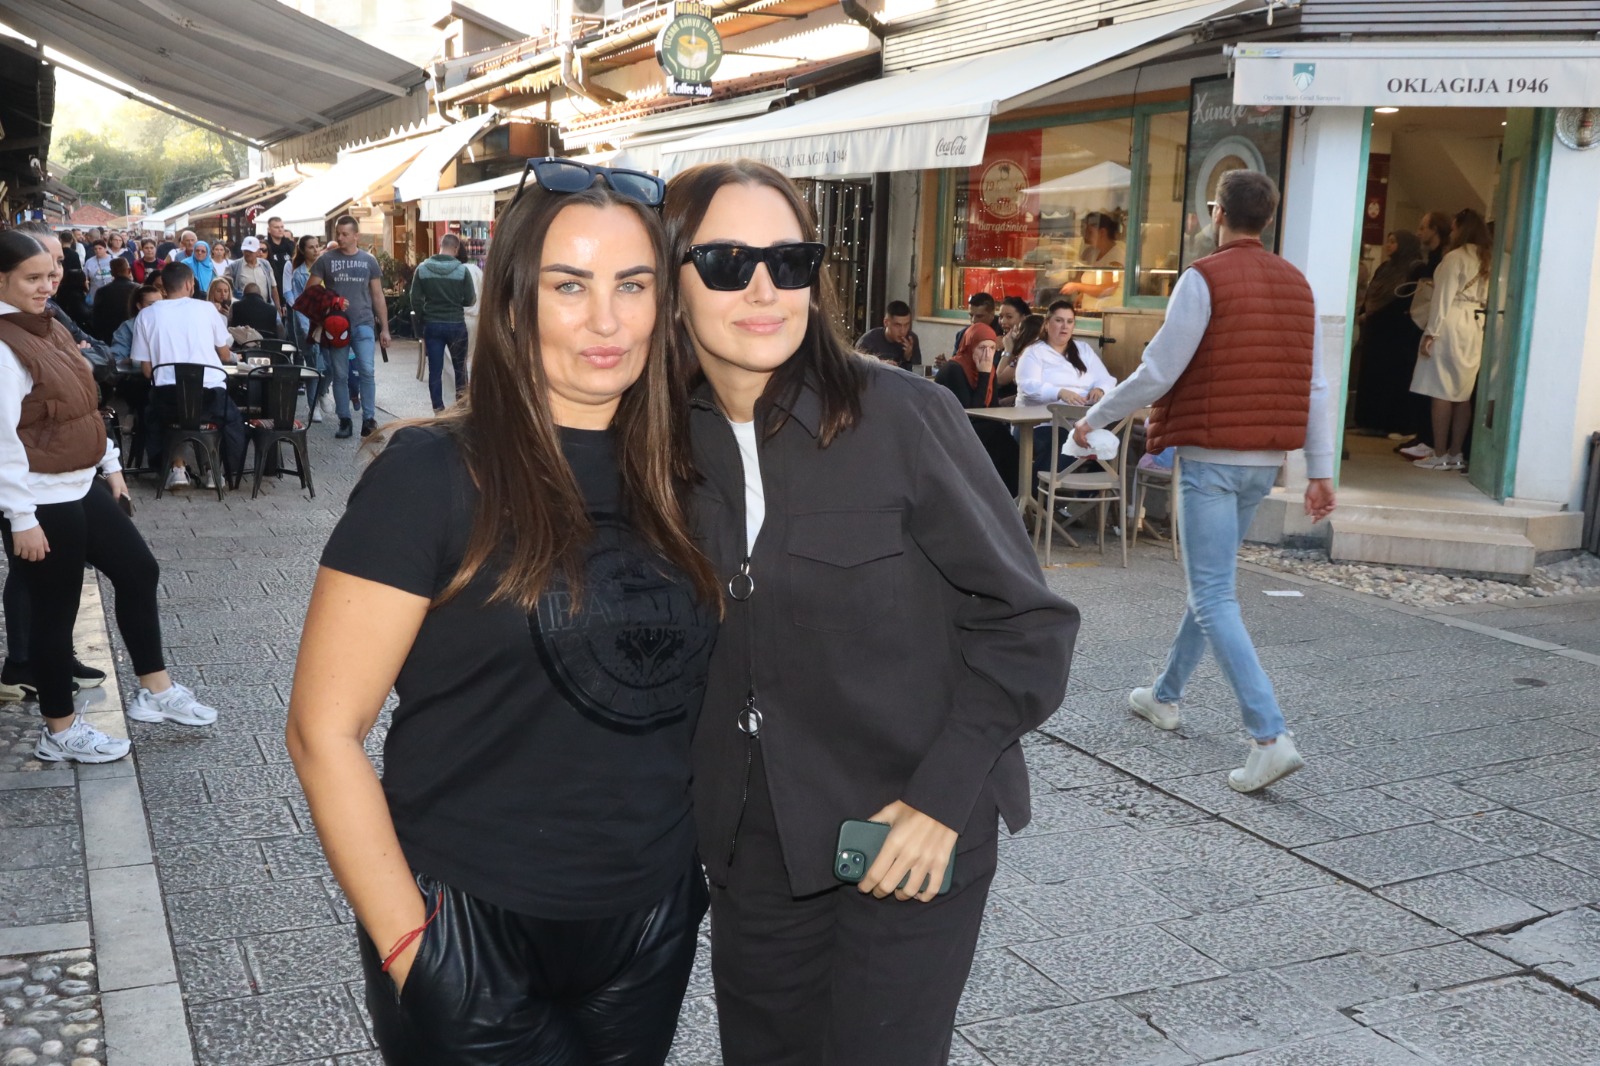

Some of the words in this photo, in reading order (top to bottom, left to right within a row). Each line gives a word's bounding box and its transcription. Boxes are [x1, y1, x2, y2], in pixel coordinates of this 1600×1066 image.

[681, 68, 701, 81] 1991
[695, 84, 713, 97] shop
[1387, 77, 1500, 94] OKLAGIJA
[1506, 77, 1549, 94] 1946
